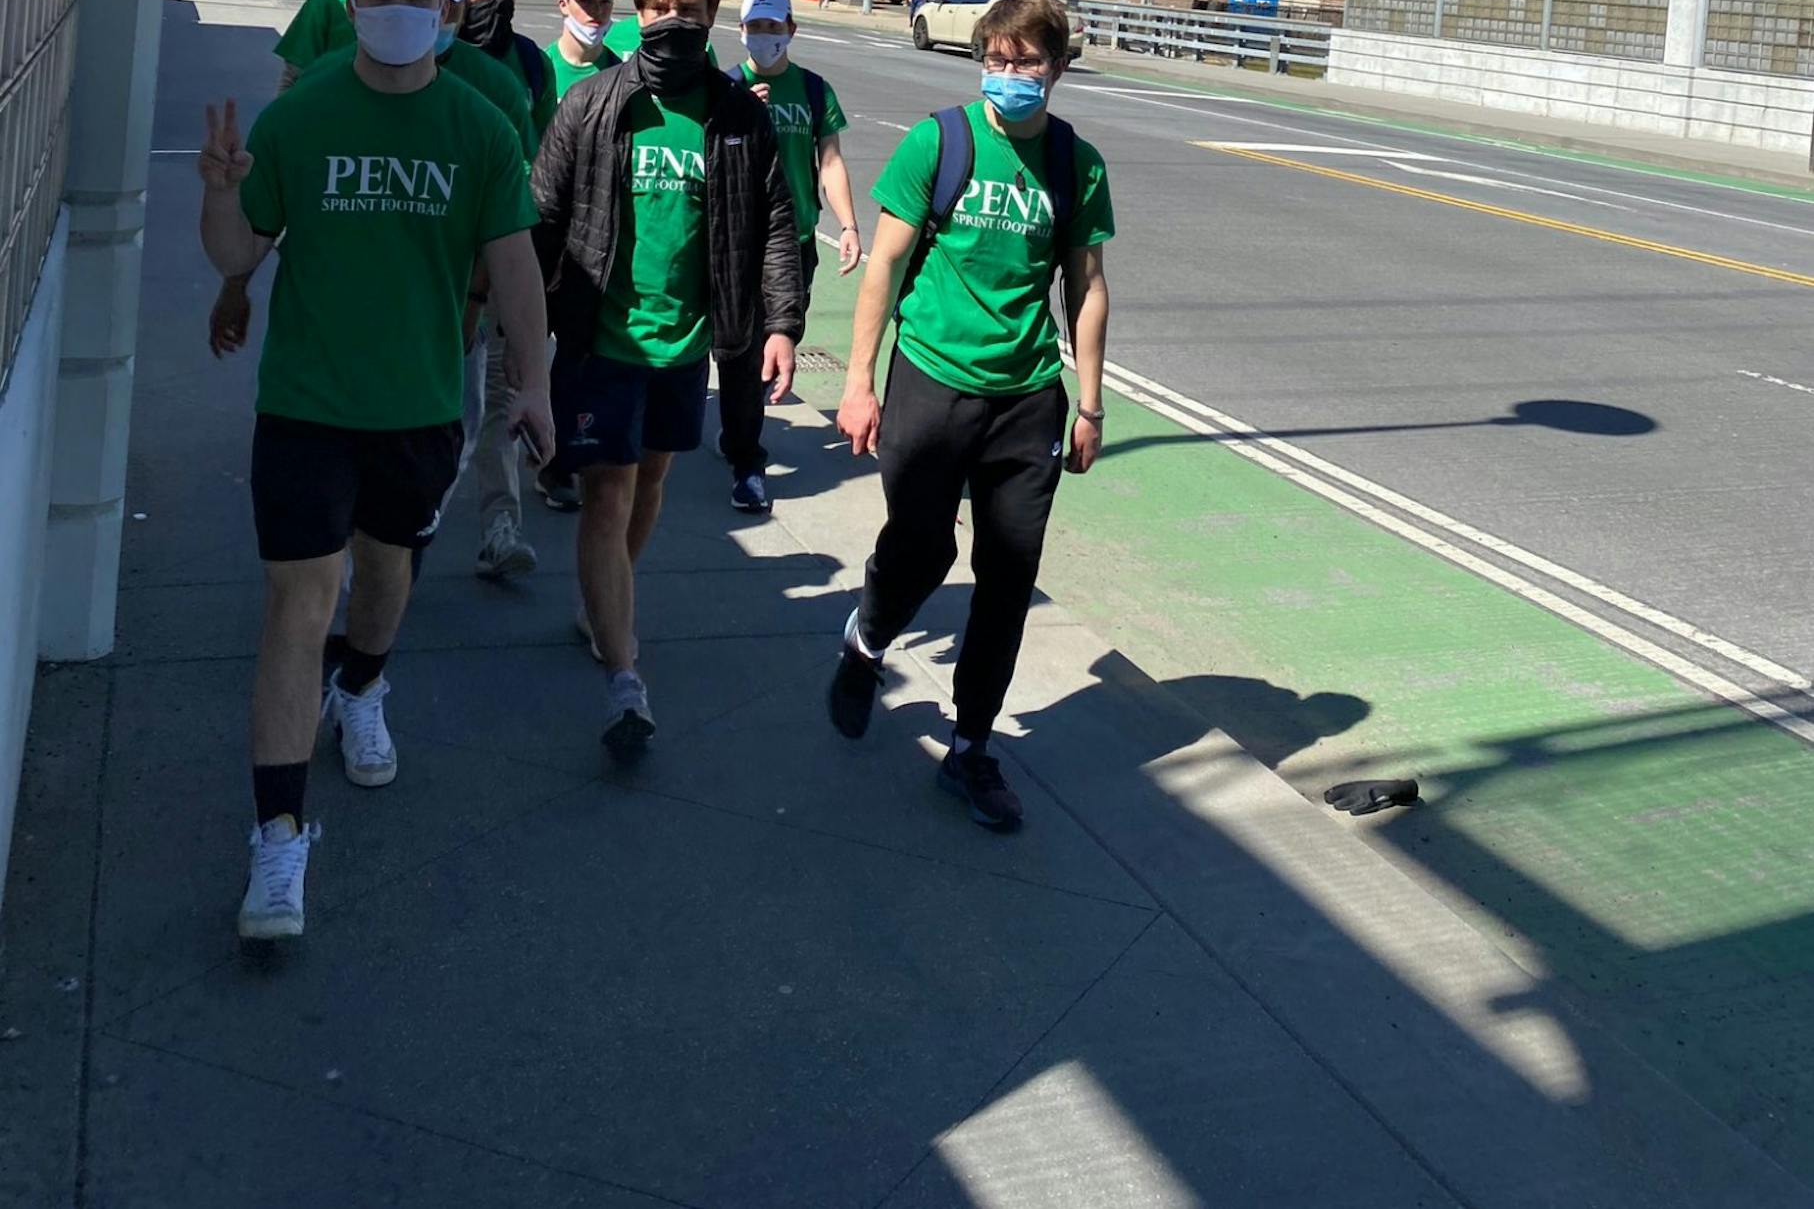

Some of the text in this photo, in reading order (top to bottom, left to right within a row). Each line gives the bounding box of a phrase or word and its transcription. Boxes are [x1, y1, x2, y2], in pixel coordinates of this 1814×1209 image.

[323, 156, 459, 201] PENN
[632, 145, 705, 180] ENN
[321, 198, 448, 216] SPRINT FOOTBALL
[953, 179, 1055, 224] PENN
[952, 212, 996, 230] SPRINT
